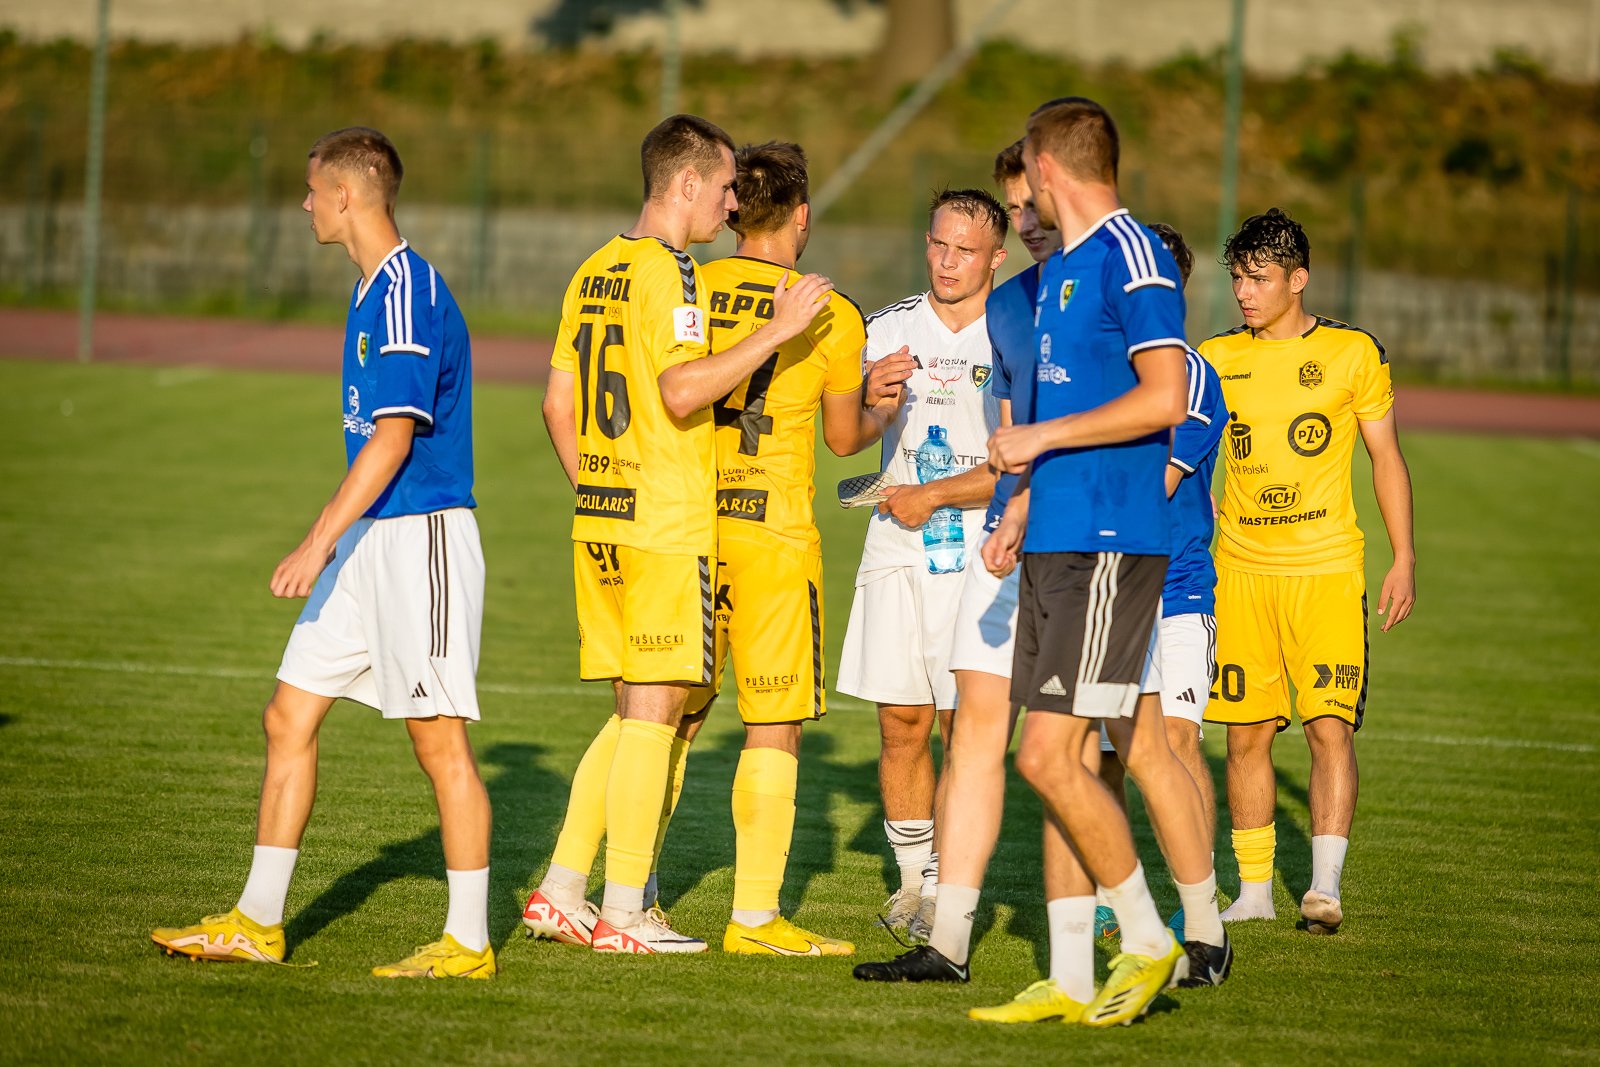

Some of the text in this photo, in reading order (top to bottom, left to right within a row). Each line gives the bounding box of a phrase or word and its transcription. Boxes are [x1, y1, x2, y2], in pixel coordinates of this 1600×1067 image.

[572, 322, 631, 440] 16
[713, 351, 779, 457] 4
[1298, 425, 1324, 444] PZU
[1242, 464, 1269, 475] Polski
[1258, 491, 1297, 505] MCH
[1238, 508, 1328, 526] MASTERCHEM
